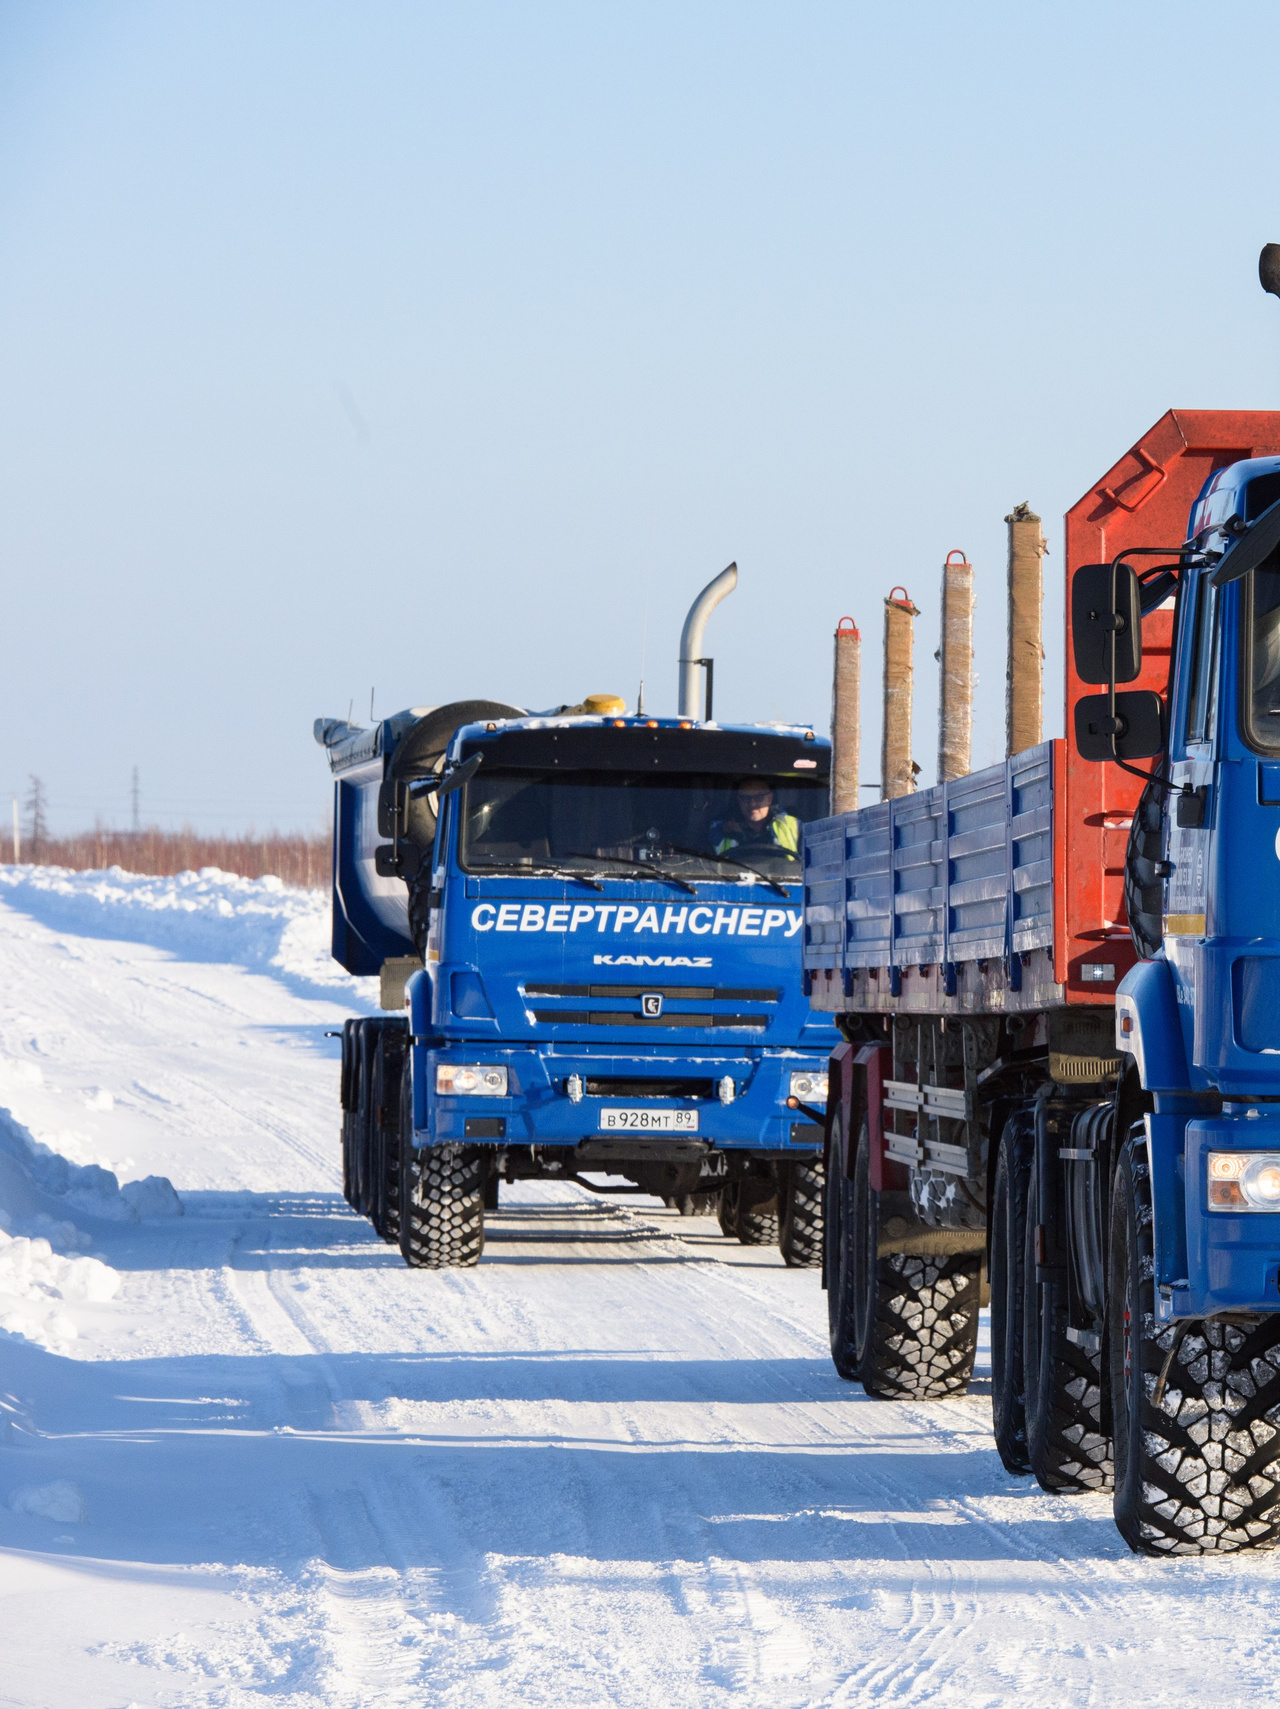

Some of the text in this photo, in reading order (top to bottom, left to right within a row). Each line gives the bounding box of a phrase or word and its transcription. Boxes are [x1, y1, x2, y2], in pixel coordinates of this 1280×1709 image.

[471, 903, 804, 938] СЕВЕРТРАНСНЕРУ
[593, 954, 713, 968] KAMAZ
[607, 1112, 692, 1127] В928МТ 89
